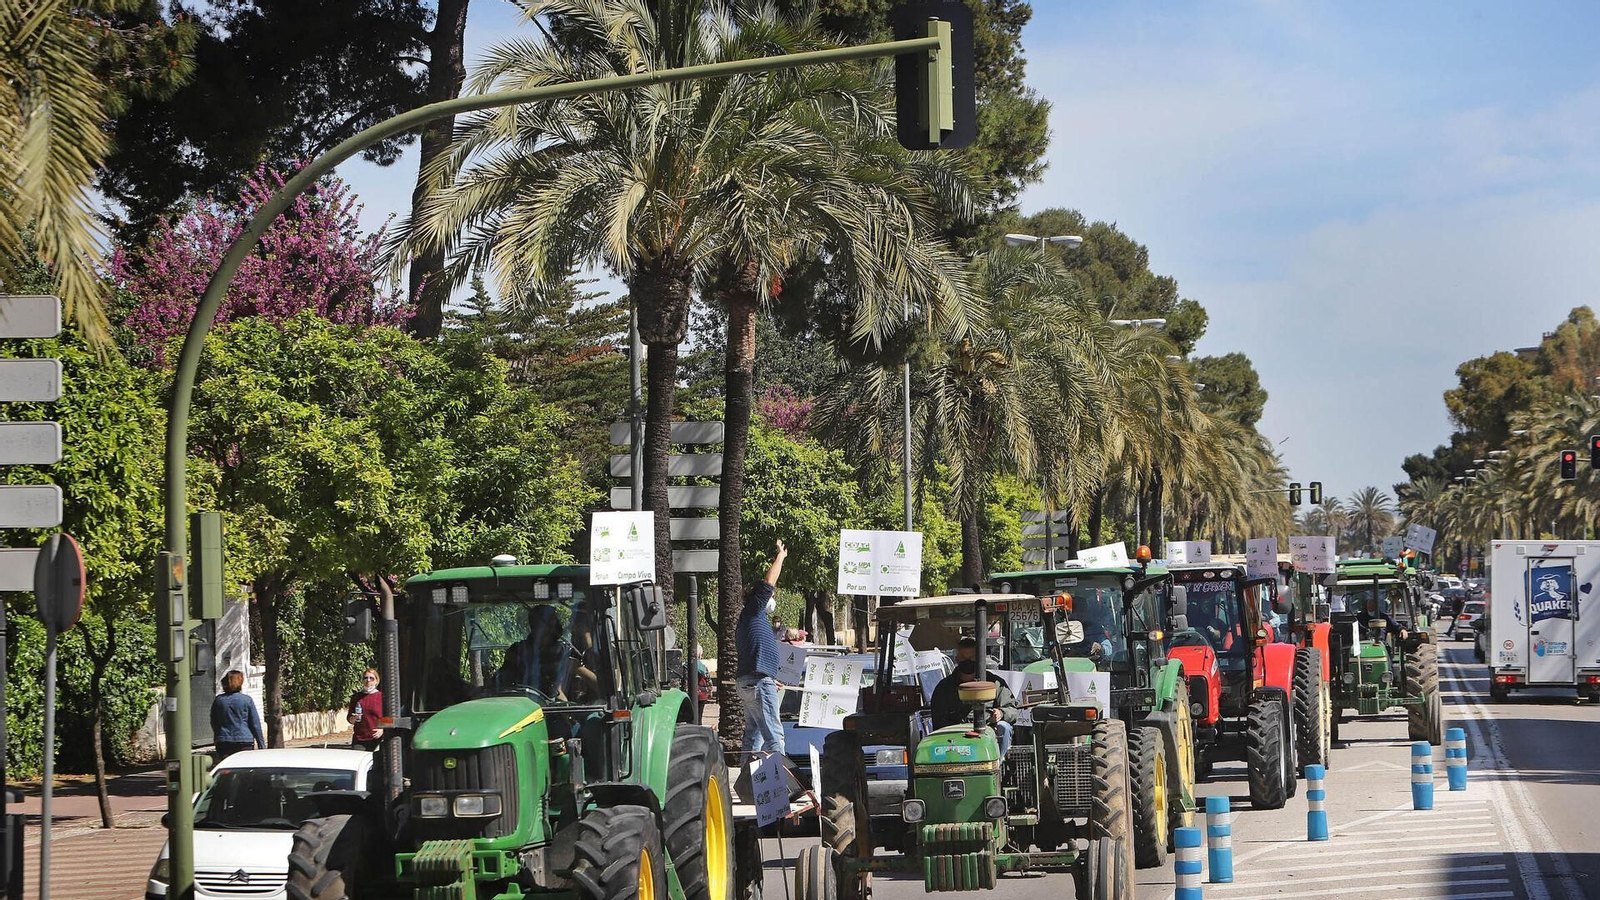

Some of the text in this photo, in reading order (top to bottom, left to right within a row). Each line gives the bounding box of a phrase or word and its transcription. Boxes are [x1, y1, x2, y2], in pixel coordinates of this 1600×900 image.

[638, 571, 652, 579] Vivo
[879, 584, 902, 593] Campo
[902, 584, 917, 593] Vivo
[1530, 600, 1573, 615] QUAKER
[1011, 612, 1039, 621] 25676
[804, 691, 813, 710] Campo
[802, 711, 810, 724] Vivo
